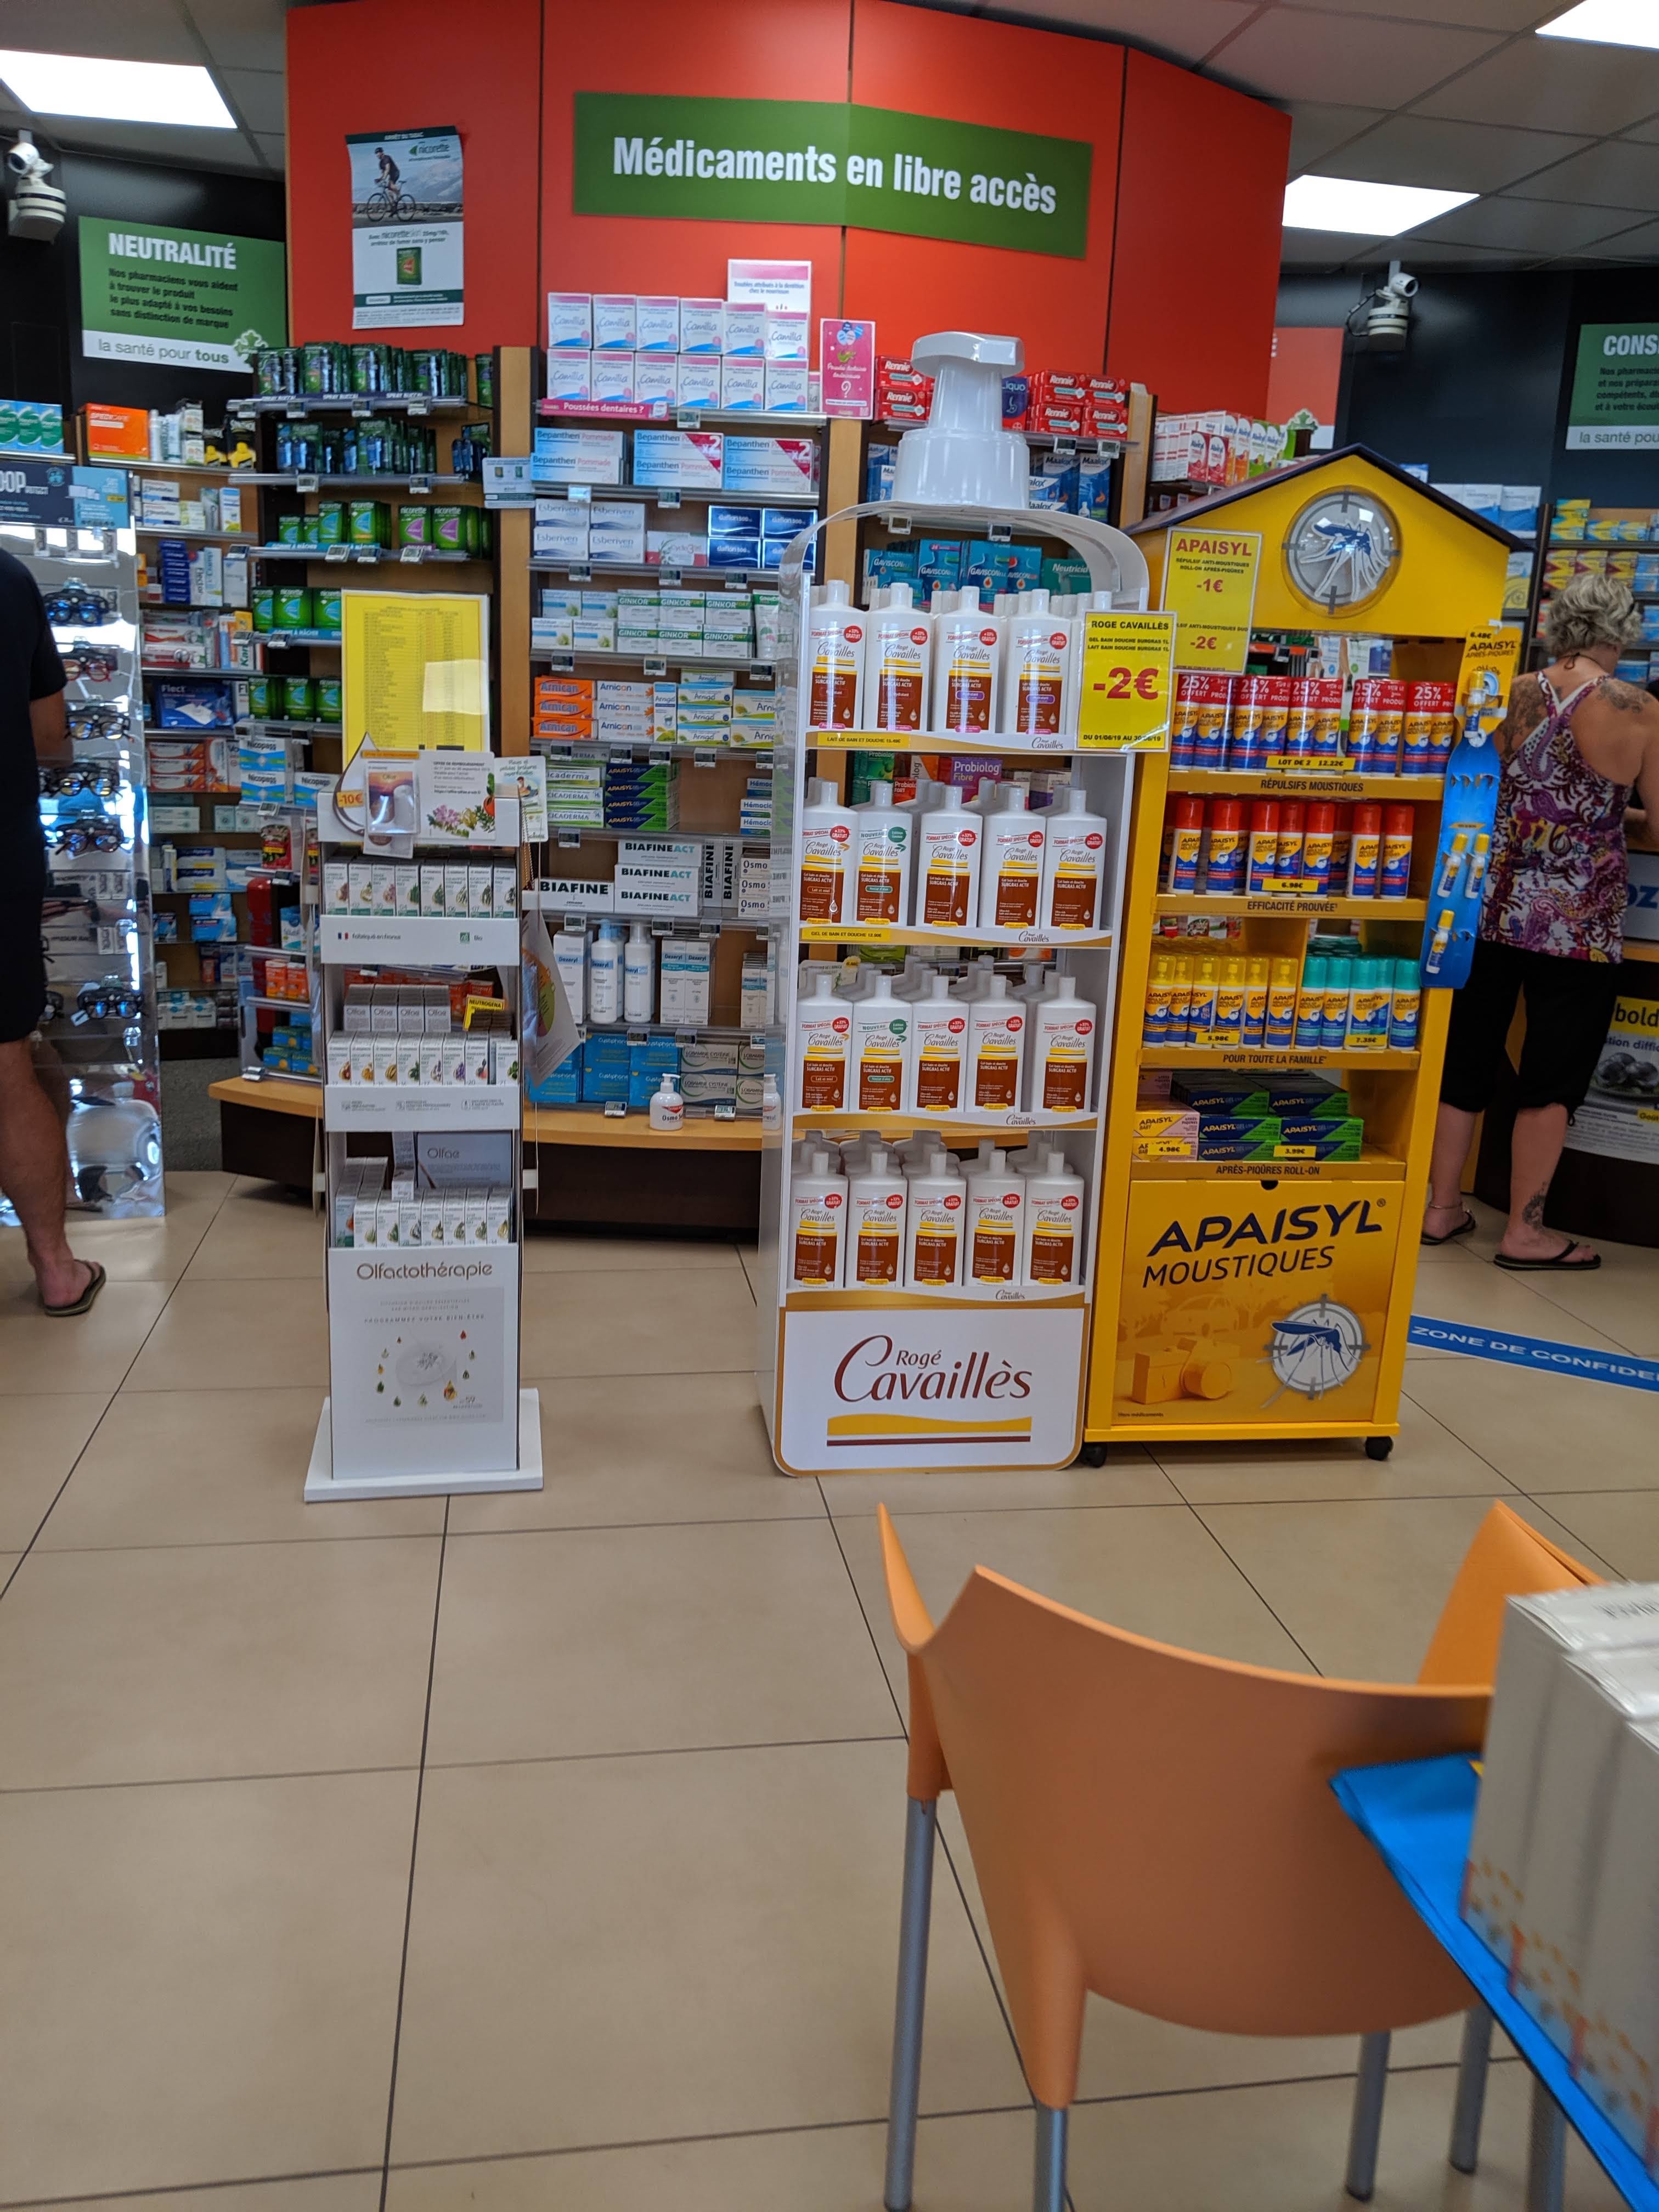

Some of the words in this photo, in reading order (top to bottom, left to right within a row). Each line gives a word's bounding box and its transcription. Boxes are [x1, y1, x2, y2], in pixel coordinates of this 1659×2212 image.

[613, 137, 836, 183] Médicaments
[847, 155, 883, 188] en
[894, 154, 961, 200] libre
[970, 172, 1057, 214] accès
[109, 233, 236, 269] NEUTRALITÉ
[128, 271, 186, 286] pharmaciens
[188, 278, 208, 288] vous
[211, 281, 238, 291] aident
[117, 283, 149, 294] trouver
[153, 286, 160, 295] le
[163, 288, 195, 299] produit
[110, 295, 119, 303] le
[121, 297, 139, 307] plus
[142, 298, 172, 311] adapté
[174, 302, 180, 310] à
[183, 304, 198, 313] vos
[200, 305, 233, 317] besoins
[111, 309, 131, 318] sans
[134, 311, 180, 324] distinction
[183, 315, 194, 325] de
[196, 318, 229, 329] marque
[729, 324, 759, 334] Camilia
[771, 331, 802, 341] Camilia
[98, 339, 111, 351] la
[116, 342, 154, 356] santé
[159, 347, 191, 360] pour
[196, 350, 229, 363] tous
[1603, 334, 1659, 356] CONS
[1049, 374, 1075, 387] Rennie
[563, 402, 599, 411] Poussées
[601, 404, 637, 413] dentaires
[537, 430, 580, 442] Bepanthen
[582, 433, 615, 441] Pommade
[636, 432, 680, 444] Bepanthen
[1579, 432, 1590, 442] la
[1594, 431, 1630, 443] santé
[1045, 455, 1073, 465] Maalox
[537, 533, 578, 543] Esberiven
[1176, 538, 1252, 556] APAISYL
[1197, 579, 1223, 592] -1€
[1120, 621, 1169, 630] CAVAILLÈS
[618, 629, 647, 637] GINKOR
[1190, 636, 1217, 650] -2€
[1468, 641, 1516, 651] APAISYL
[600, 683, 631, 691] Arnican
[1093, 667, 1159, 700] -2€
[1415, 686, 1441, 699] 25%
[953, 761, 1000, 776] Probiolog
[1278, 758, 1291, 766] LOT
[1294, 758, 1303, 766] DE
[1318, 759, 1344, 768] 12.22€
[953, 774, 973, 782] Fibre
[1261, 778, 1307, 791] RÉPULSIFS
[1308, 780, 1363, 792] MOUSTIQUES
[338, 793, 364, 804] -10€
[743, 860, 768, 869] Osmo
[540, 881, 608, 895] BIAFINE
[1248, 901, 1295, 911] EFFICACITÉ
[469, 999, 502, 1008] NEUTROGENA
[1223, 1054, 1245, 1063] POUR
[1248, 1054, 1274, 1064] TOUTE
[1277, 1055, 1287, 1064] LA
[1139, 1116, 1173, 1125] APAISYL
[1216, 1164, 1282, 1175] APRÈS-PIQÛRES
[1284, 1165, 1319, 1175] ROLL-ON
[1147, 1200, 1382, 1257] APAISYL
[357, 1261, 493, 1281] Olfactothérapie
[1142, 1246, 1335, 1288] MOUSTIQUES
[1411, 1326, 1484, 1347] ZONE
[1489, 1341, 1526, 1355] DE
[896, 1349, 942, 1369] Rogé
[834, 1334, 1032, 1403] Cavaillès
